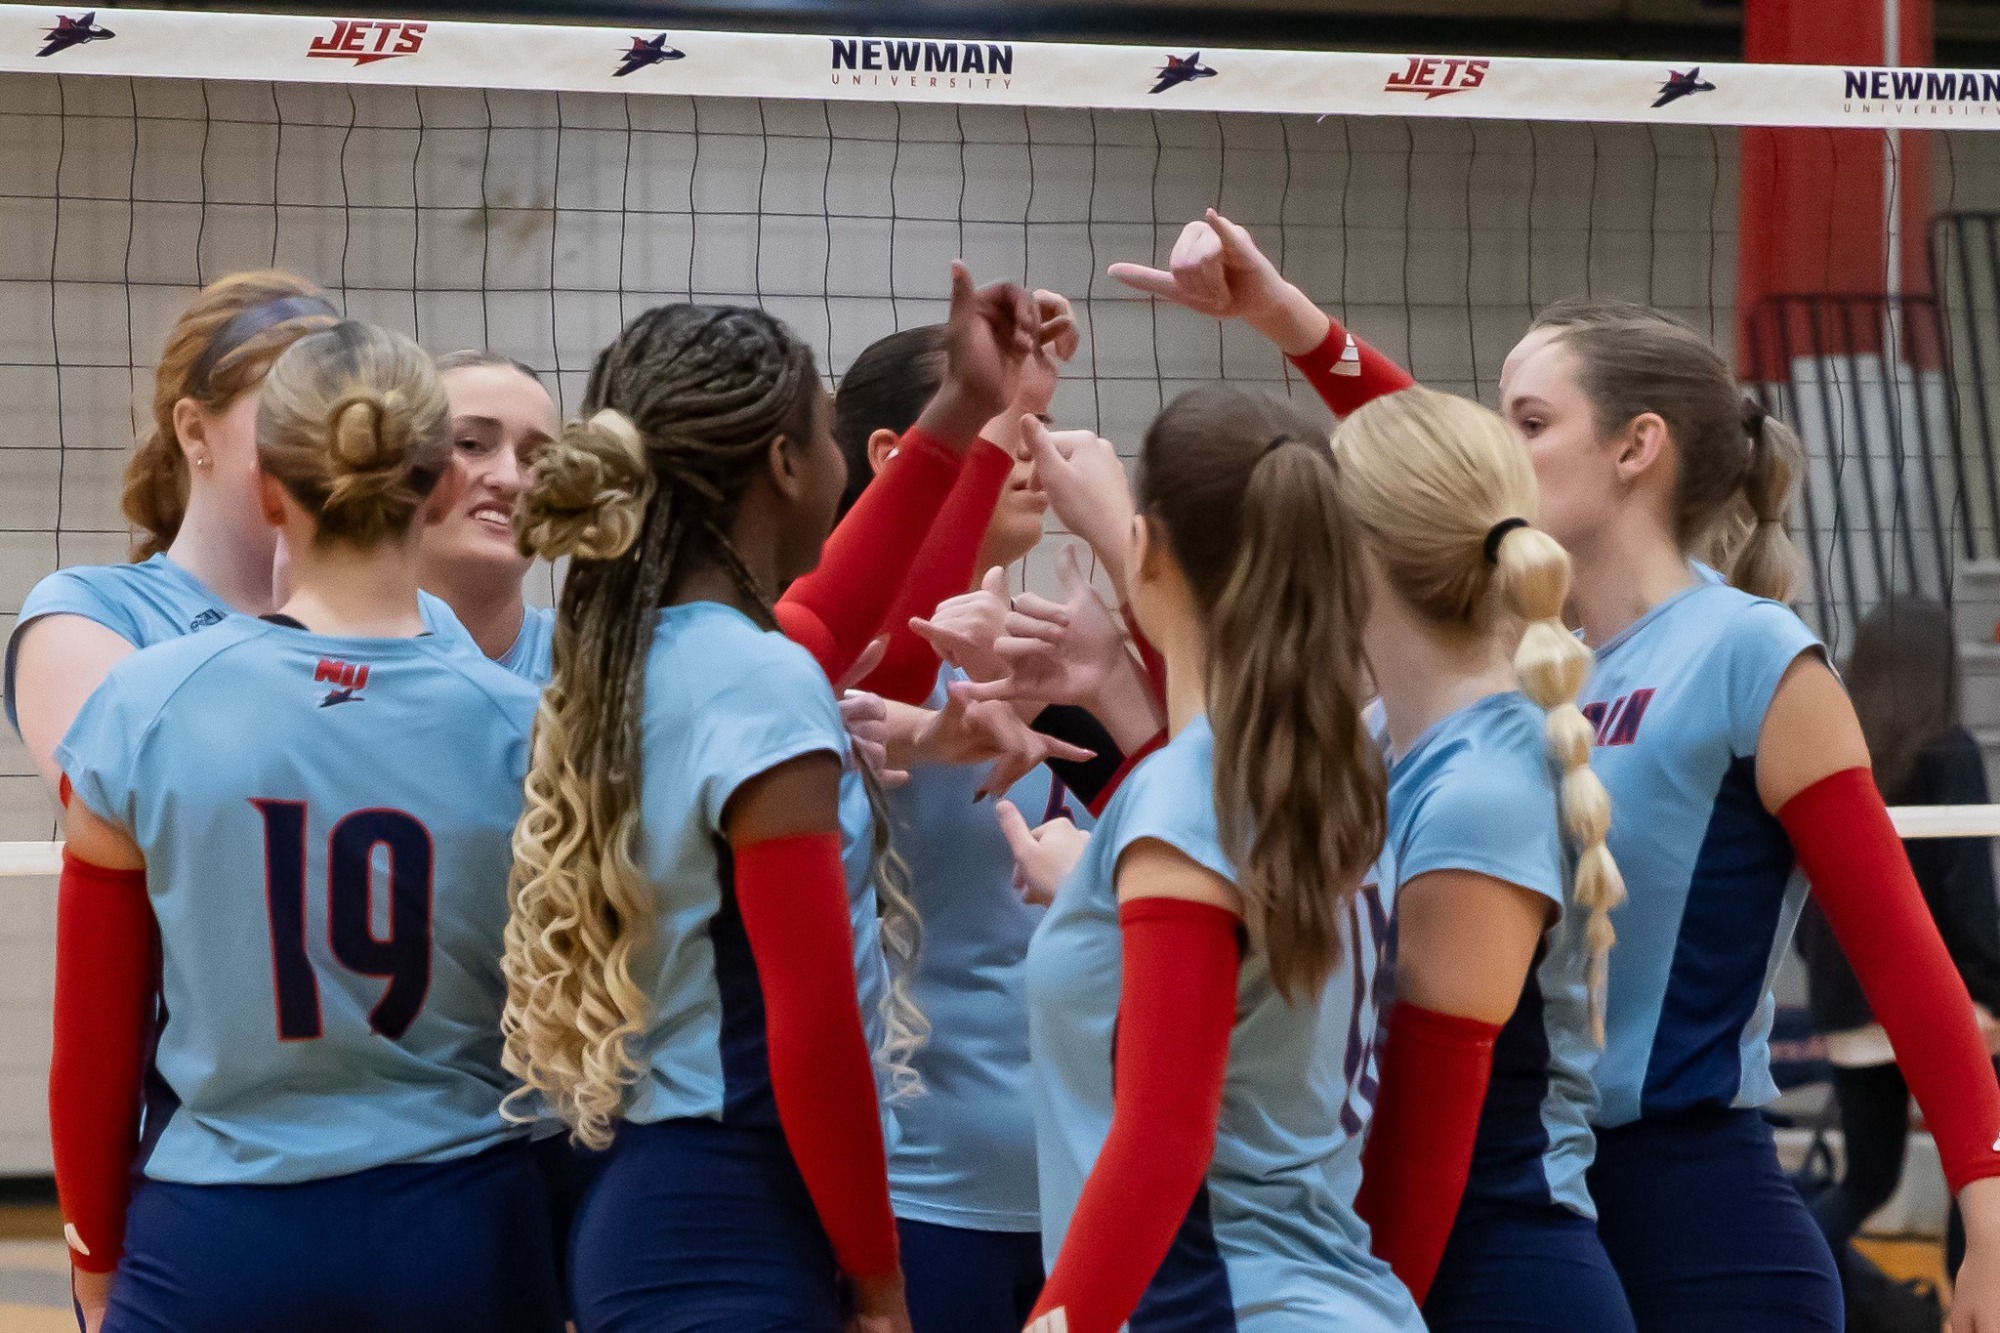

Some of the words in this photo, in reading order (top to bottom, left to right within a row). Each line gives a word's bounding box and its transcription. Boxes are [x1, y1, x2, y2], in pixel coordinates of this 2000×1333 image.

[309, 20, 428, 53] JETS
[830, 39, 1013, 74] NEWMAN
[1386, 57, 1490, 87] JETS
[831, 74, 1011, 89] UNIVERSITY
[1844, 70, 2000, 101] NEWMAN
[314, 658, 369, 690] NU
[247, 797, 434, 1041] 19
